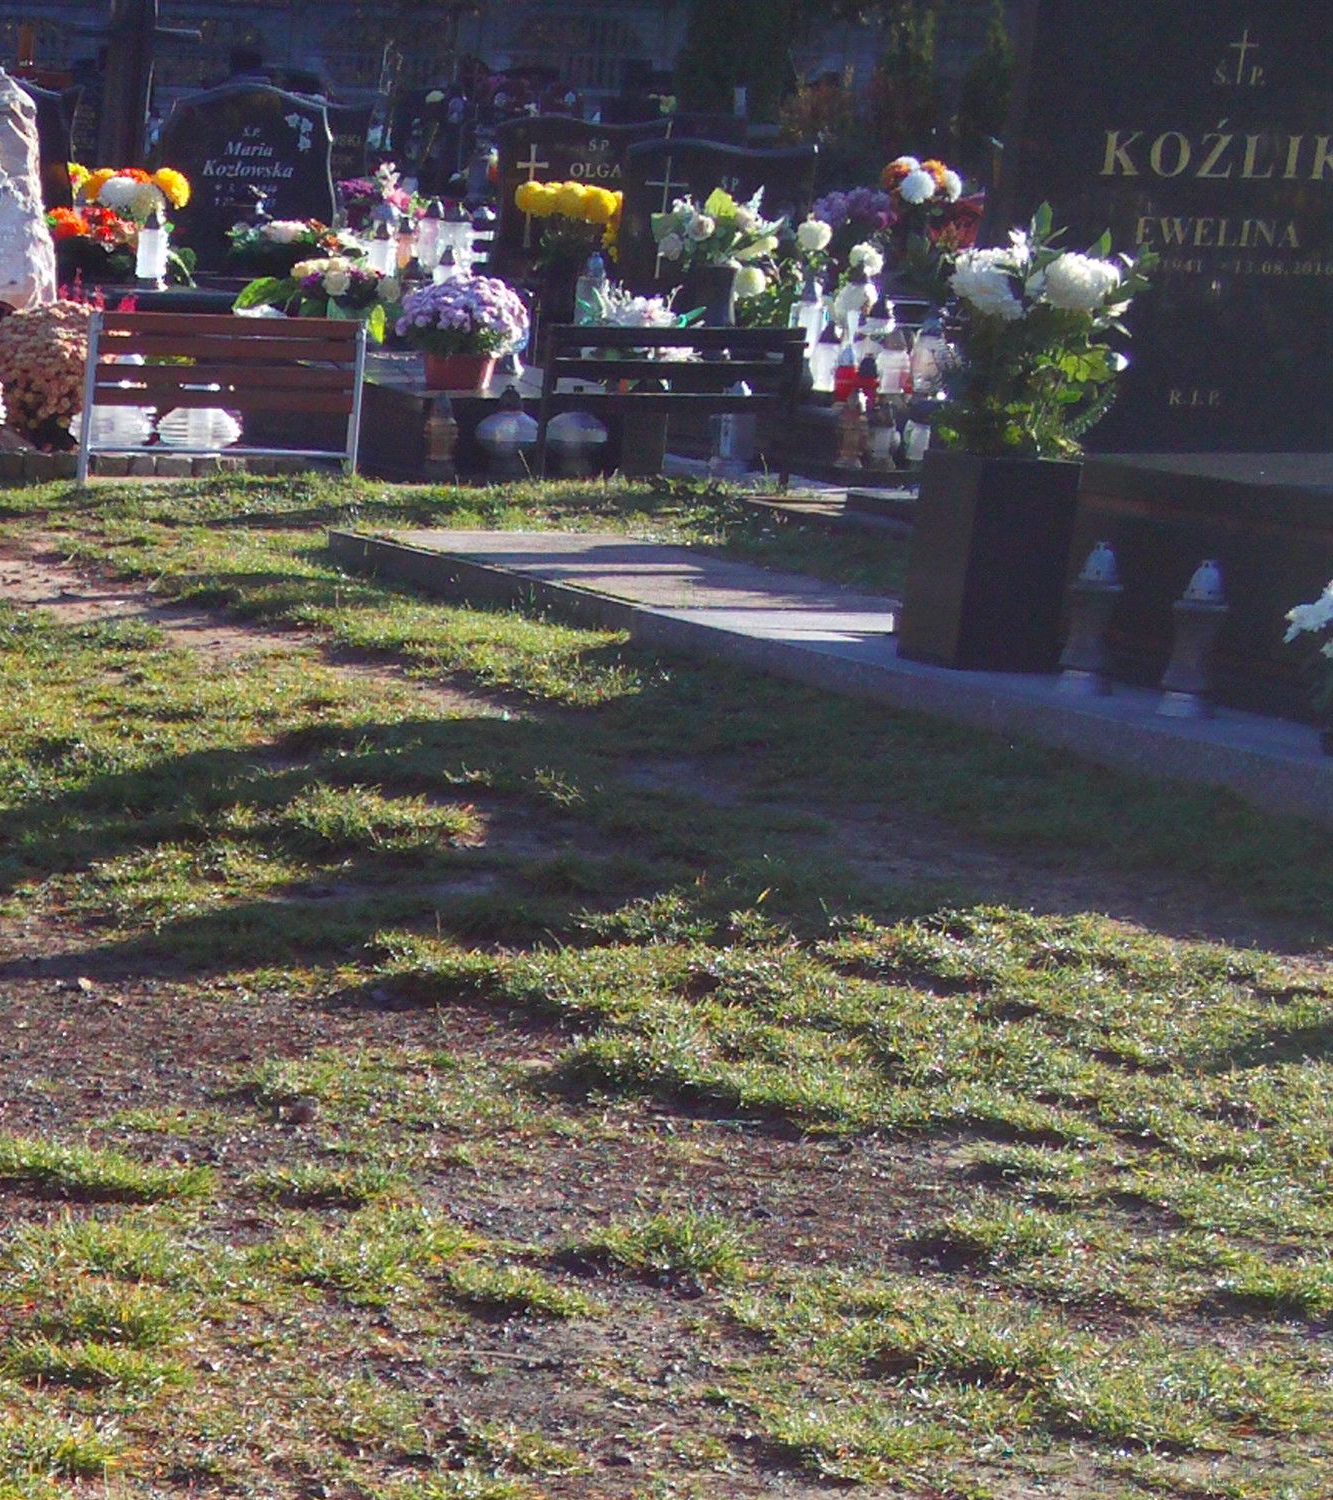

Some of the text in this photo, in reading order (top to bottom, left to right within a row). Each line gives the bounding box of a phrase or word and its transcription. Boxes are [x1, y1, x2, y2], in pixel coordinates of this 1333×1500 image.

[224, 142, 274, 157] Maria
[201, 160, 295, 180] Kozłowska
[570, 162, 622, 179] OLGA
[1134, 215, 1300, 248] EWELINA
